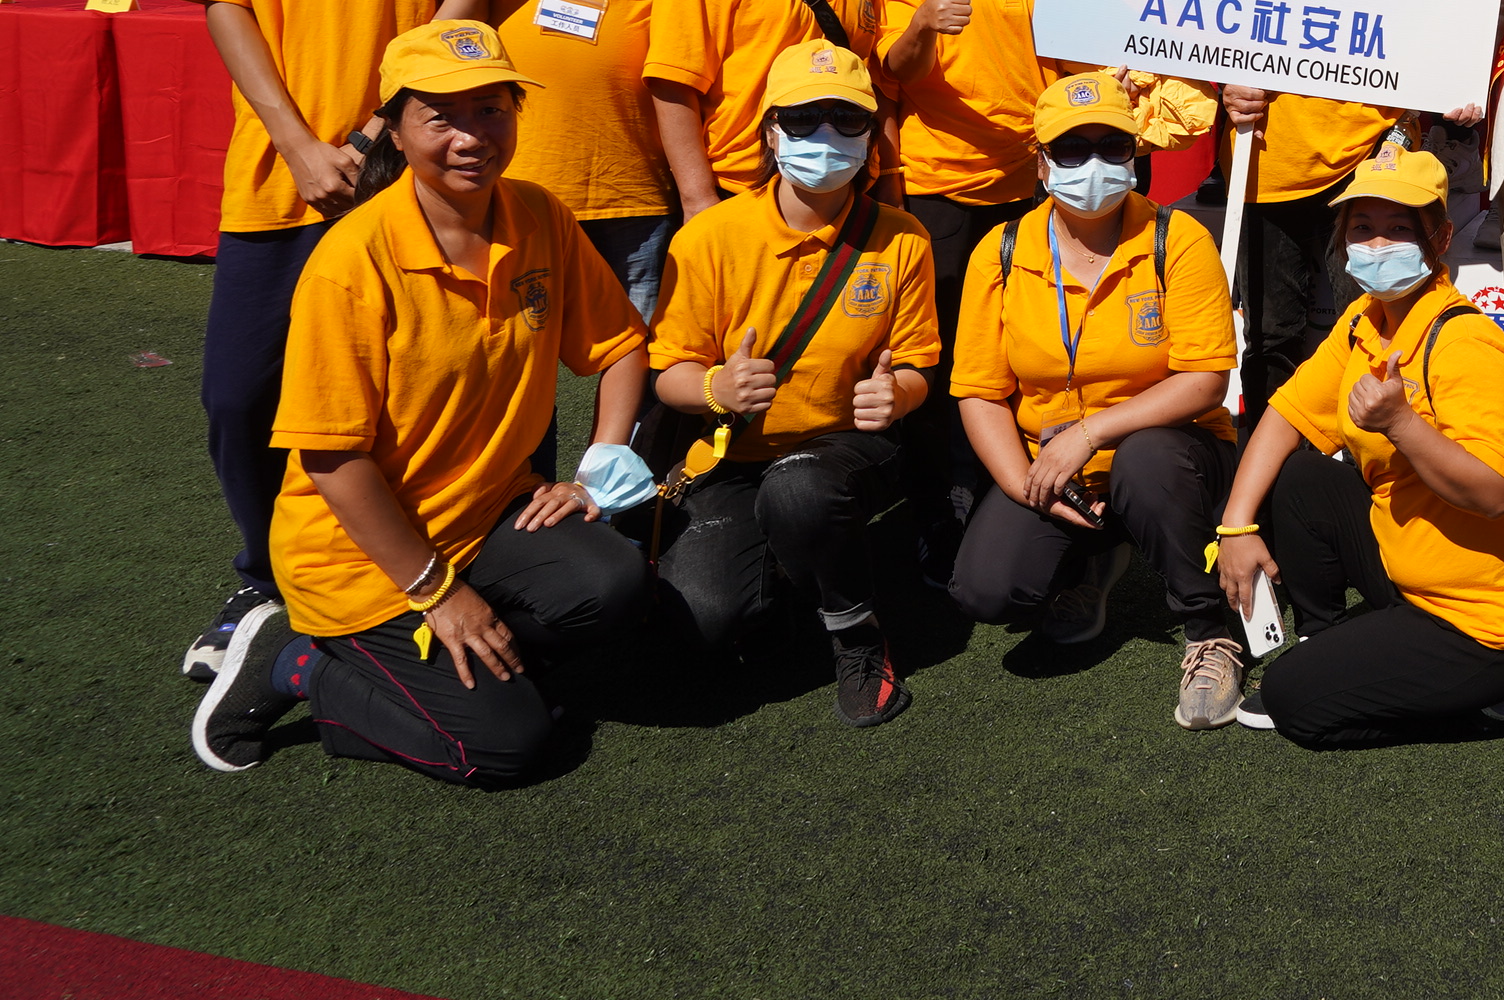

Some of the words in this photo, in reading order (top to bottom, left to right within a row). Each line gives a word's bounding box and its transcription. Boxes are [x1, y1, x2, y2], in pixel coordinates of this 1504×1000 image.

[553, 12, 584, 25] VOLUNTEER
[1124, 33, 1184, 61] ASIAN
[1188, 43, 1292, 77] AMERICAN
[1296, 57, 1400, 91] COHESION
[857, 288, 879, 299] AAC
[1143, 317, 1161, 328] AAC
